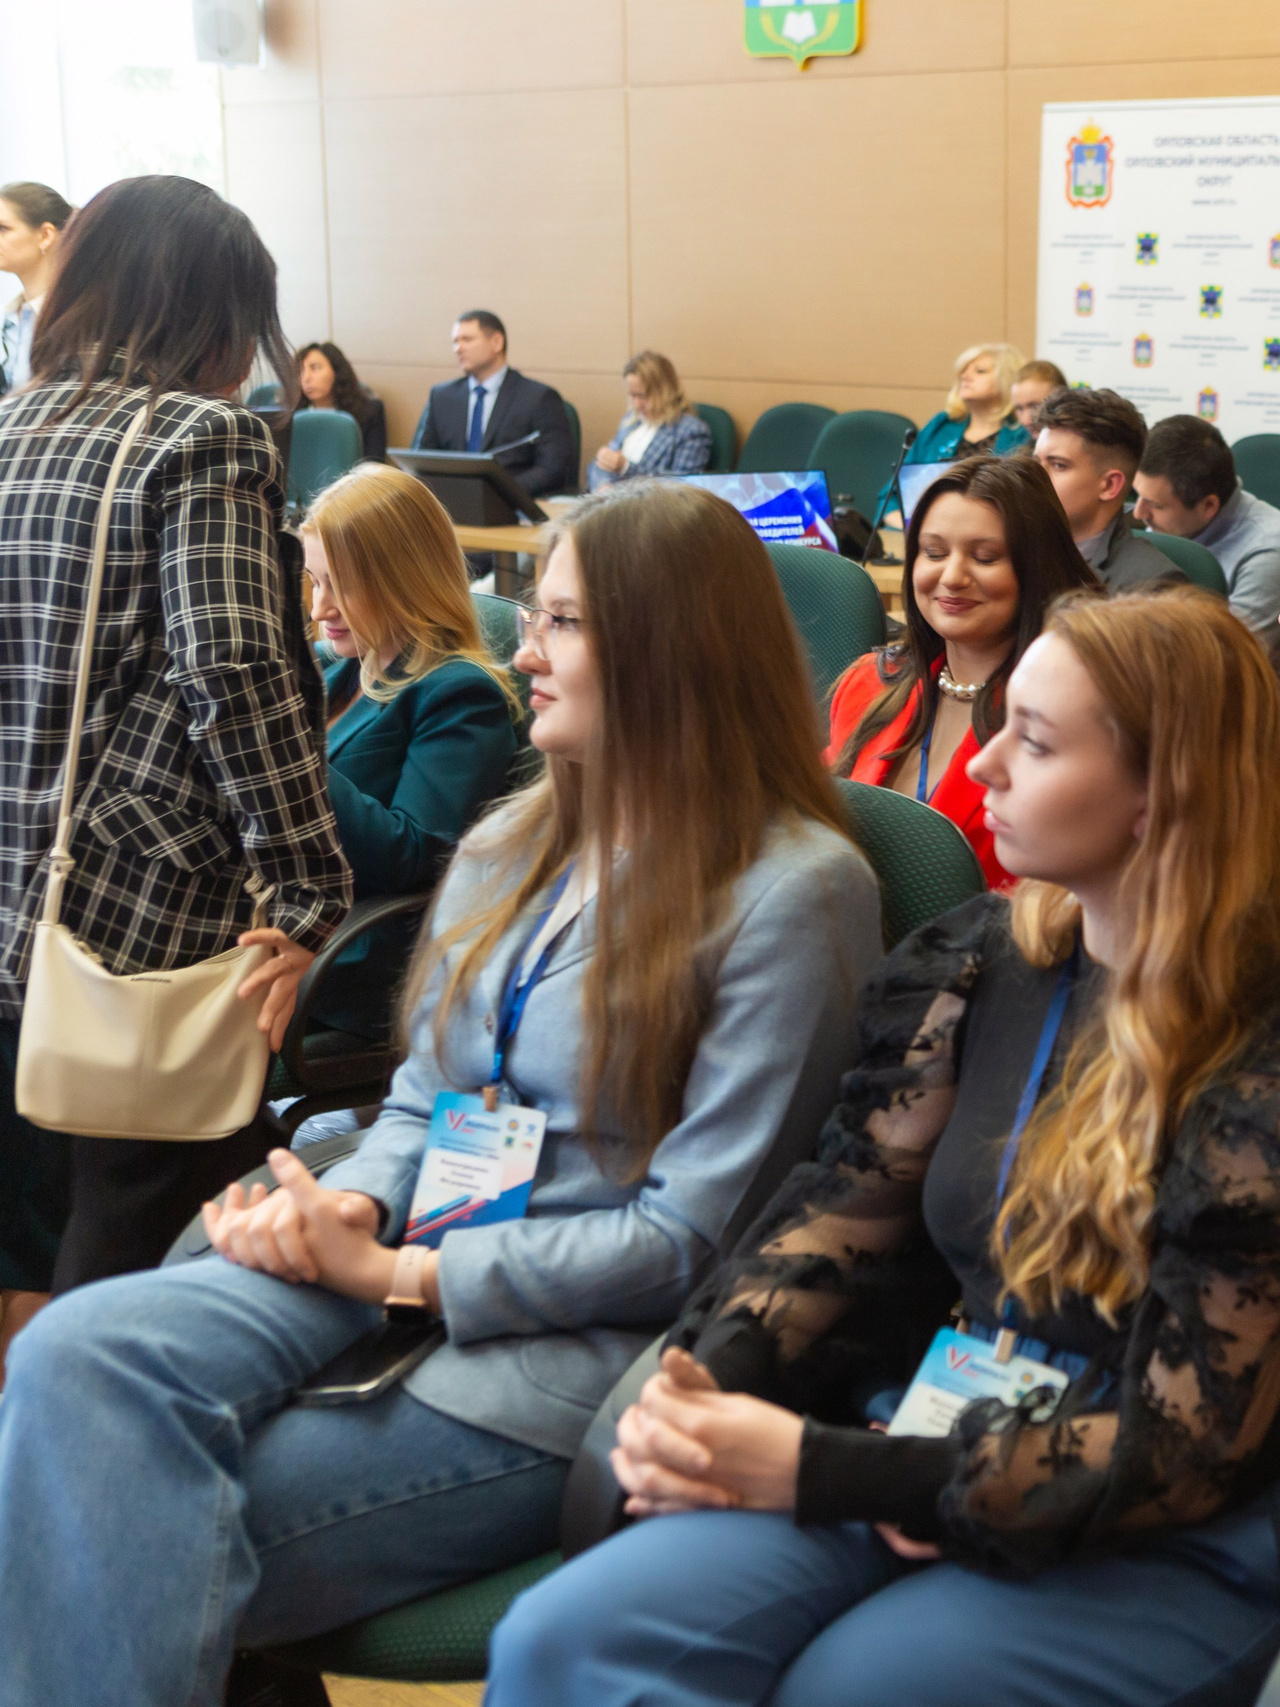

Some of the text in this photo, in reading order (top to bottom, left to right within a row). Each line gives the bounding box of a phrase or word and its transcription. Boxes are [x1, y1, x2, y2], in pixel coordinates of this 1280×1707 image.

[1154, 134, 1280, 147] ОРЛОВСКАЯ ОБЛАСТЬ
[1126, 155, 1194, 168] ОРЛОВСКИЙ
[1197, 175, 1233, 187] ОКРУГ
[759, 515, 803, 527] ЦЕРЕМОНИЯ
